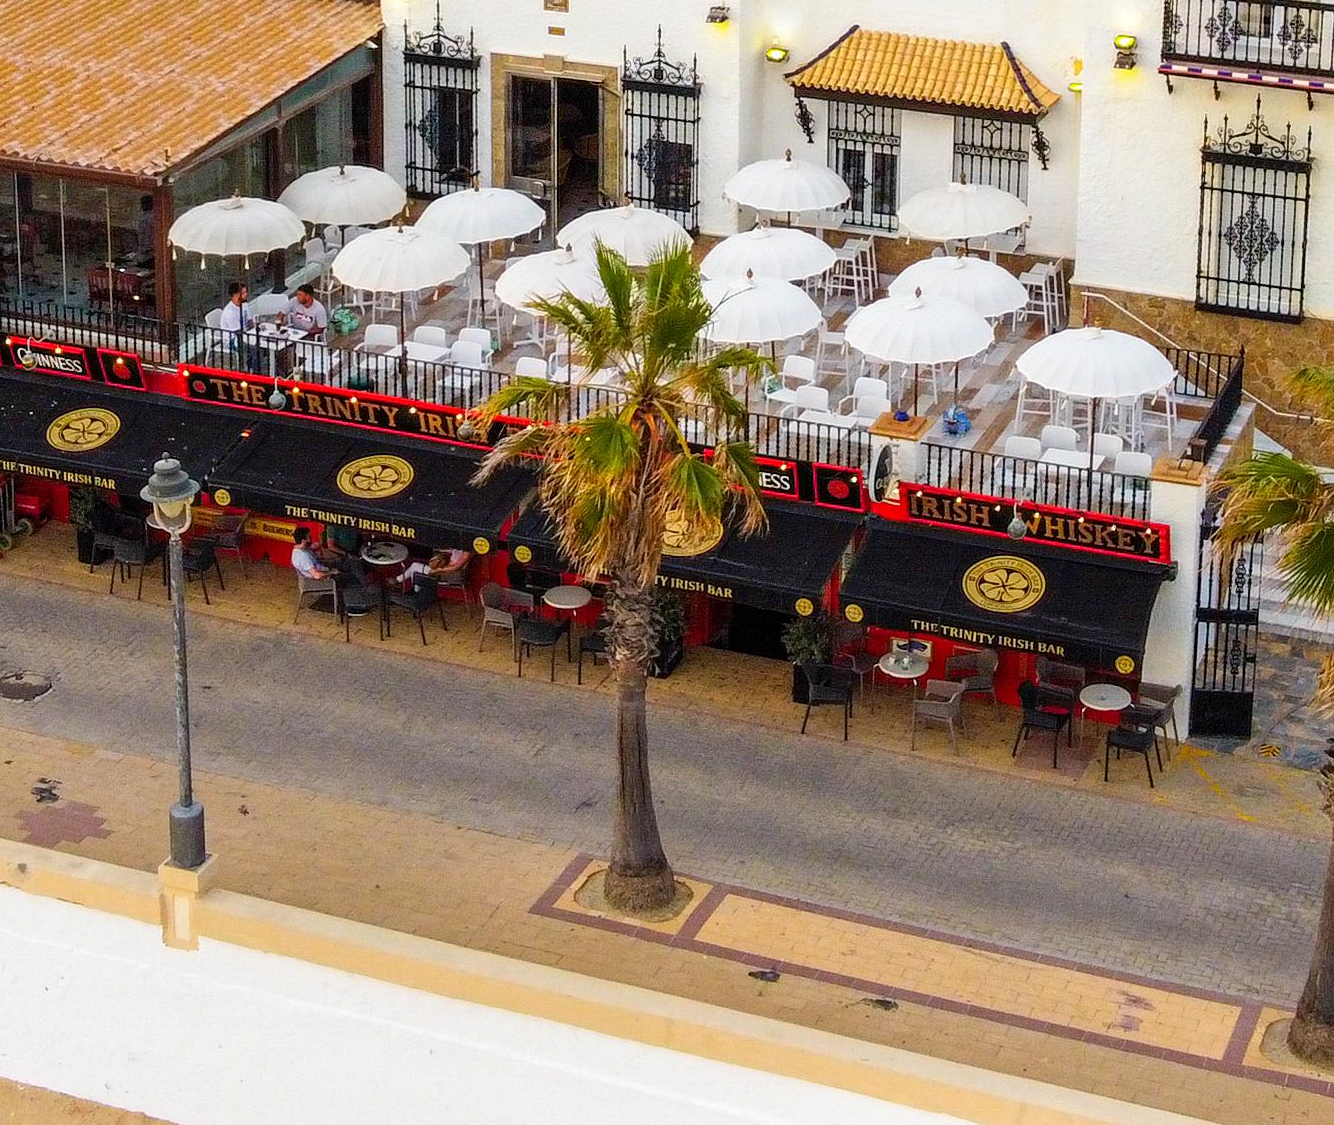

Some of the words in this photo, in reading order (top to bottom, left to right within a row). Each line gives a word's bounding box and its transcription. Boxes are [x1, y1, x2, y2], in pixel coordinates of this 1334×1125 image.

[209, 378, 267, 406] THE
[286, 389, 398, 427] TRINITY
[18, 463, 61, 480] TRINITY
[63, 472, 92, 485] IRISH
[94, 476, 117, 490] BAR
[285, 505, 308, 519] THE
[310, 509, 357, 528] TRINITY
[358, 518, 391, 533] IRISH
[392, 524, 416, 539] BAR
[911, 493, 990, 527] IRISH
[1020, 511, 1160, 555] WHISKEY
[670, 577, 705, 591] IRISH
[707, 584, 733, 598] BAR
[911, 619, 938, 632] THE
[940, 625, 996, 644] TRINITY
[998, 636, 1036, 650] IRISH
[1038, 641, 1065, 657] BAR
